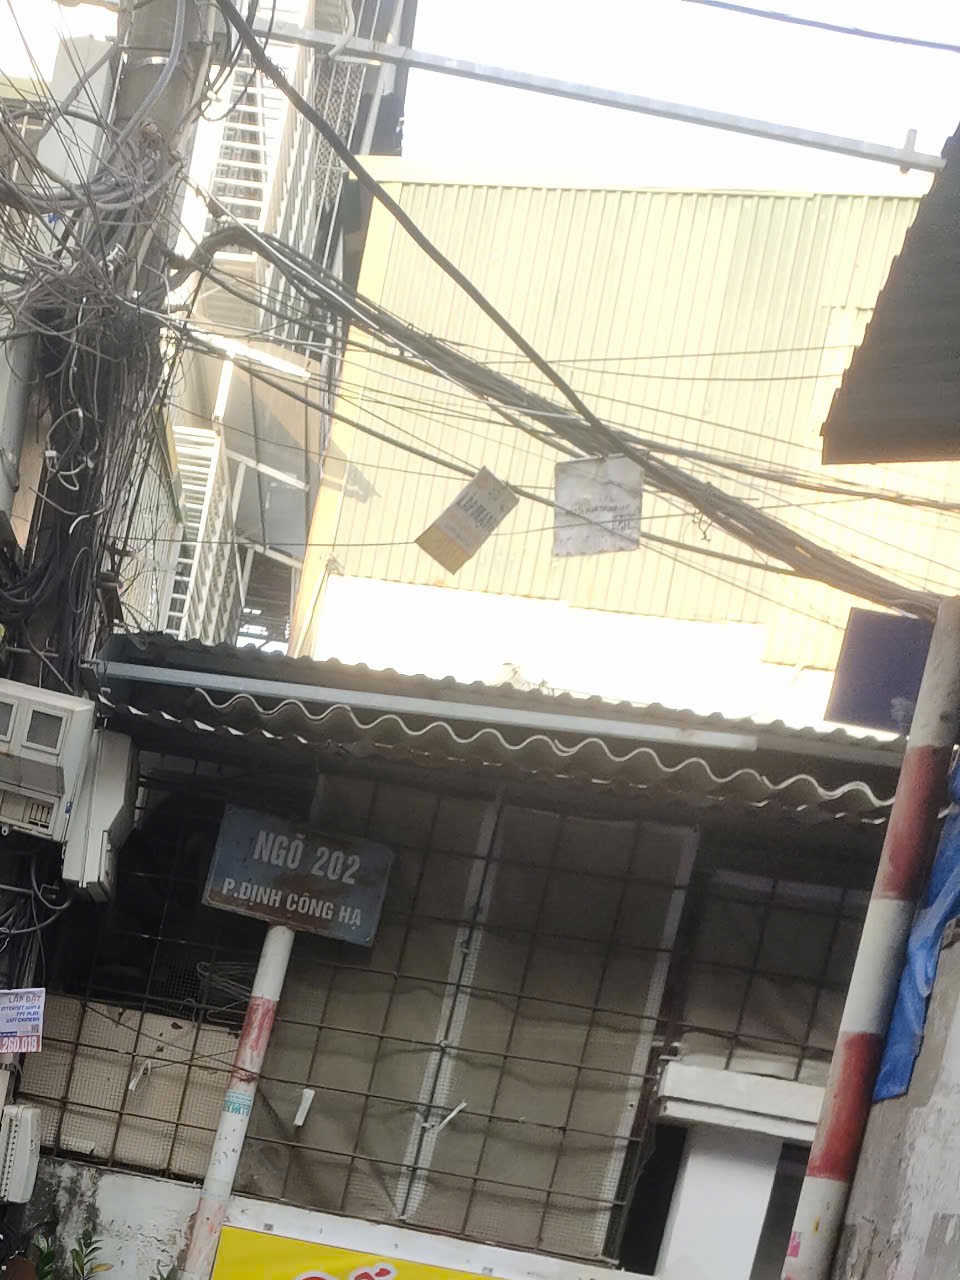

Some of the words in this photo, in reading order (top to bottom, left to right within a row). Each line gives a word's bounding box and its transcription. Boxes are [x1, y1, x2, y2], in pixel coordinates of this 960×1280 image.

[253, 830, 306, 870] NGÕ
[311, 846, 361, 885] 202
[286, 892, 334, 920] CÔNG
[338, 905, 361, 930] HẠ
